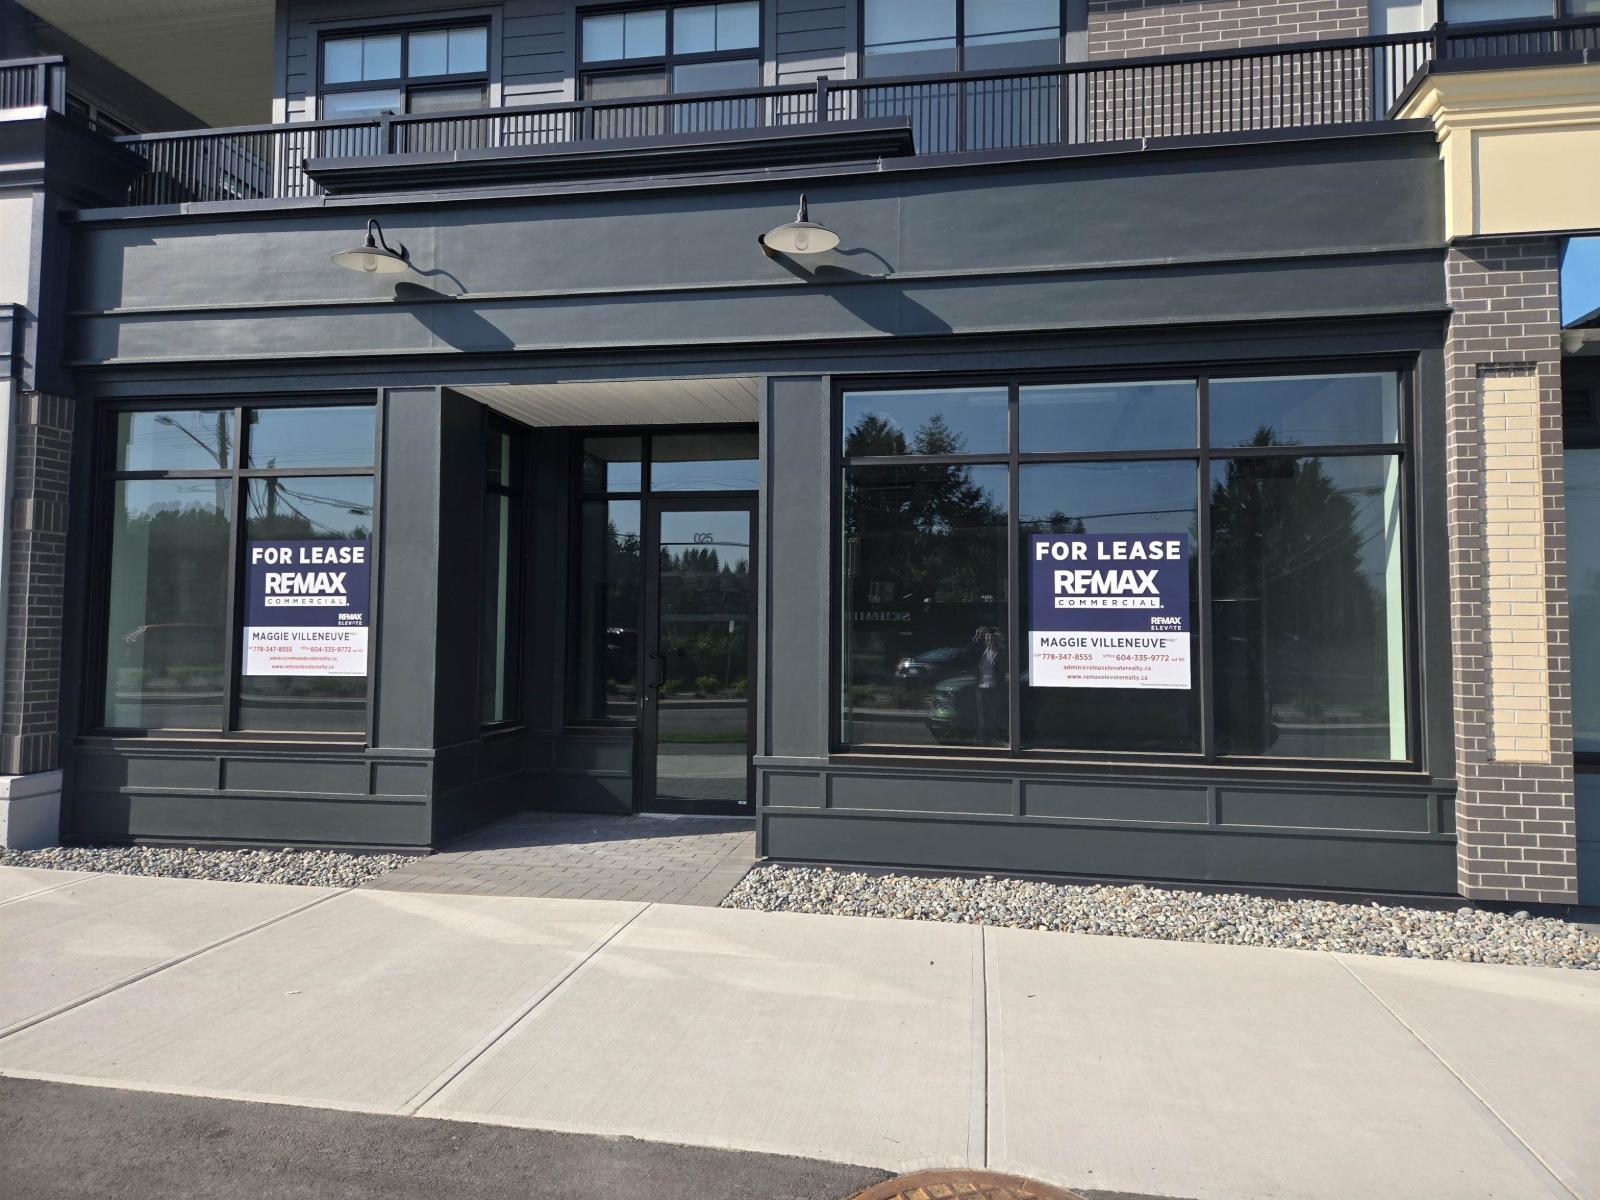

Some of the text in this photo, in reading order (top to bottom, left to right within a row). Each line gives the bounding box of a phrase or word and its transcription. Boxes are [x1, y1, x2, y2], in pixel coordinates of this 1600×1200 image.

[252, 547, 364, 564] FOR LEASE
[1036, 541, 1181, 561] FOR LEASE
[252, 632, 289, 641] MAGGIE
[292, 632, 350, 641] VILLENEUVE
[1040, 638, 1166, 648] MAGGIE VILLENEUVE
